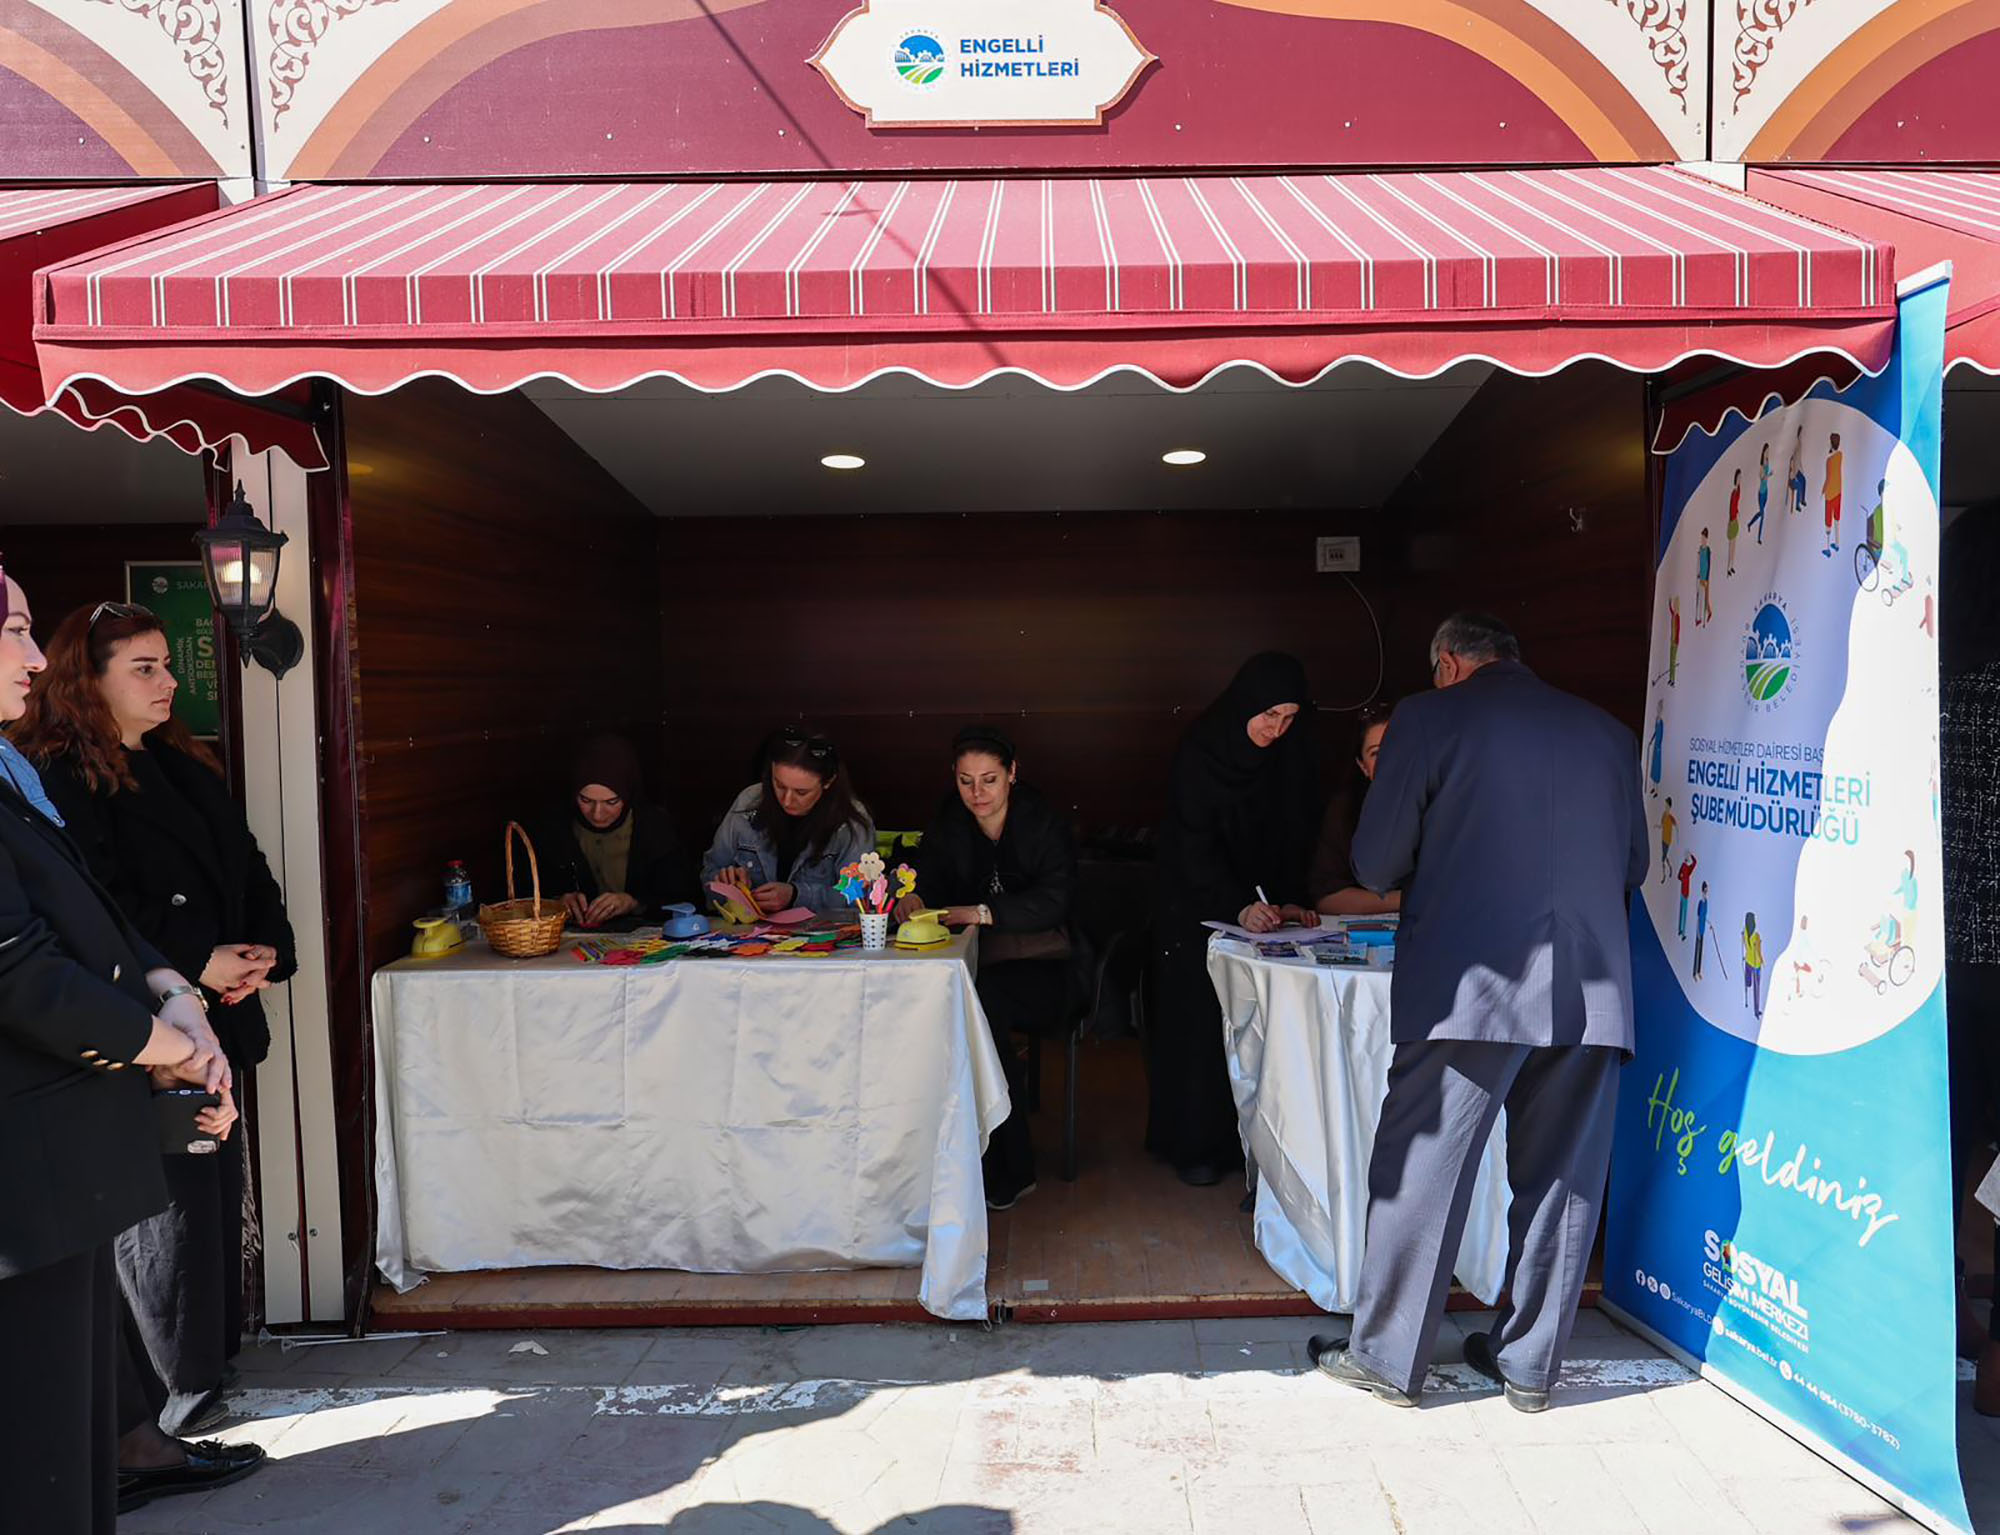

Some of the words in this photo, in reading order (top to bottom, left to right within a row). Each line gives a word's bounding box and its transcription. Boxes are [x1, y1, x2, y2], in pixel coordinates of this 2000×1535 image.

[959, 35, 1043, 53] ENGELLİ
[960, 58, 1079, 77] HİZMETLERİ
[198, 635, 215, 658] S
[1689, 738, 1717, 753] SOSYAL
[1757, 742, 1802, 760] DAİRESİ
[1687, 758, 1741, 791] ENGELLİ
[1746, 761, 1871, 806] HİZMETLERİ
[1648, 1067, 1707, 1176] Hoş
[1718, 1129, 1900, 1248] geldiniz
[1703, 1229, 1809, 1319] SOSYAL
